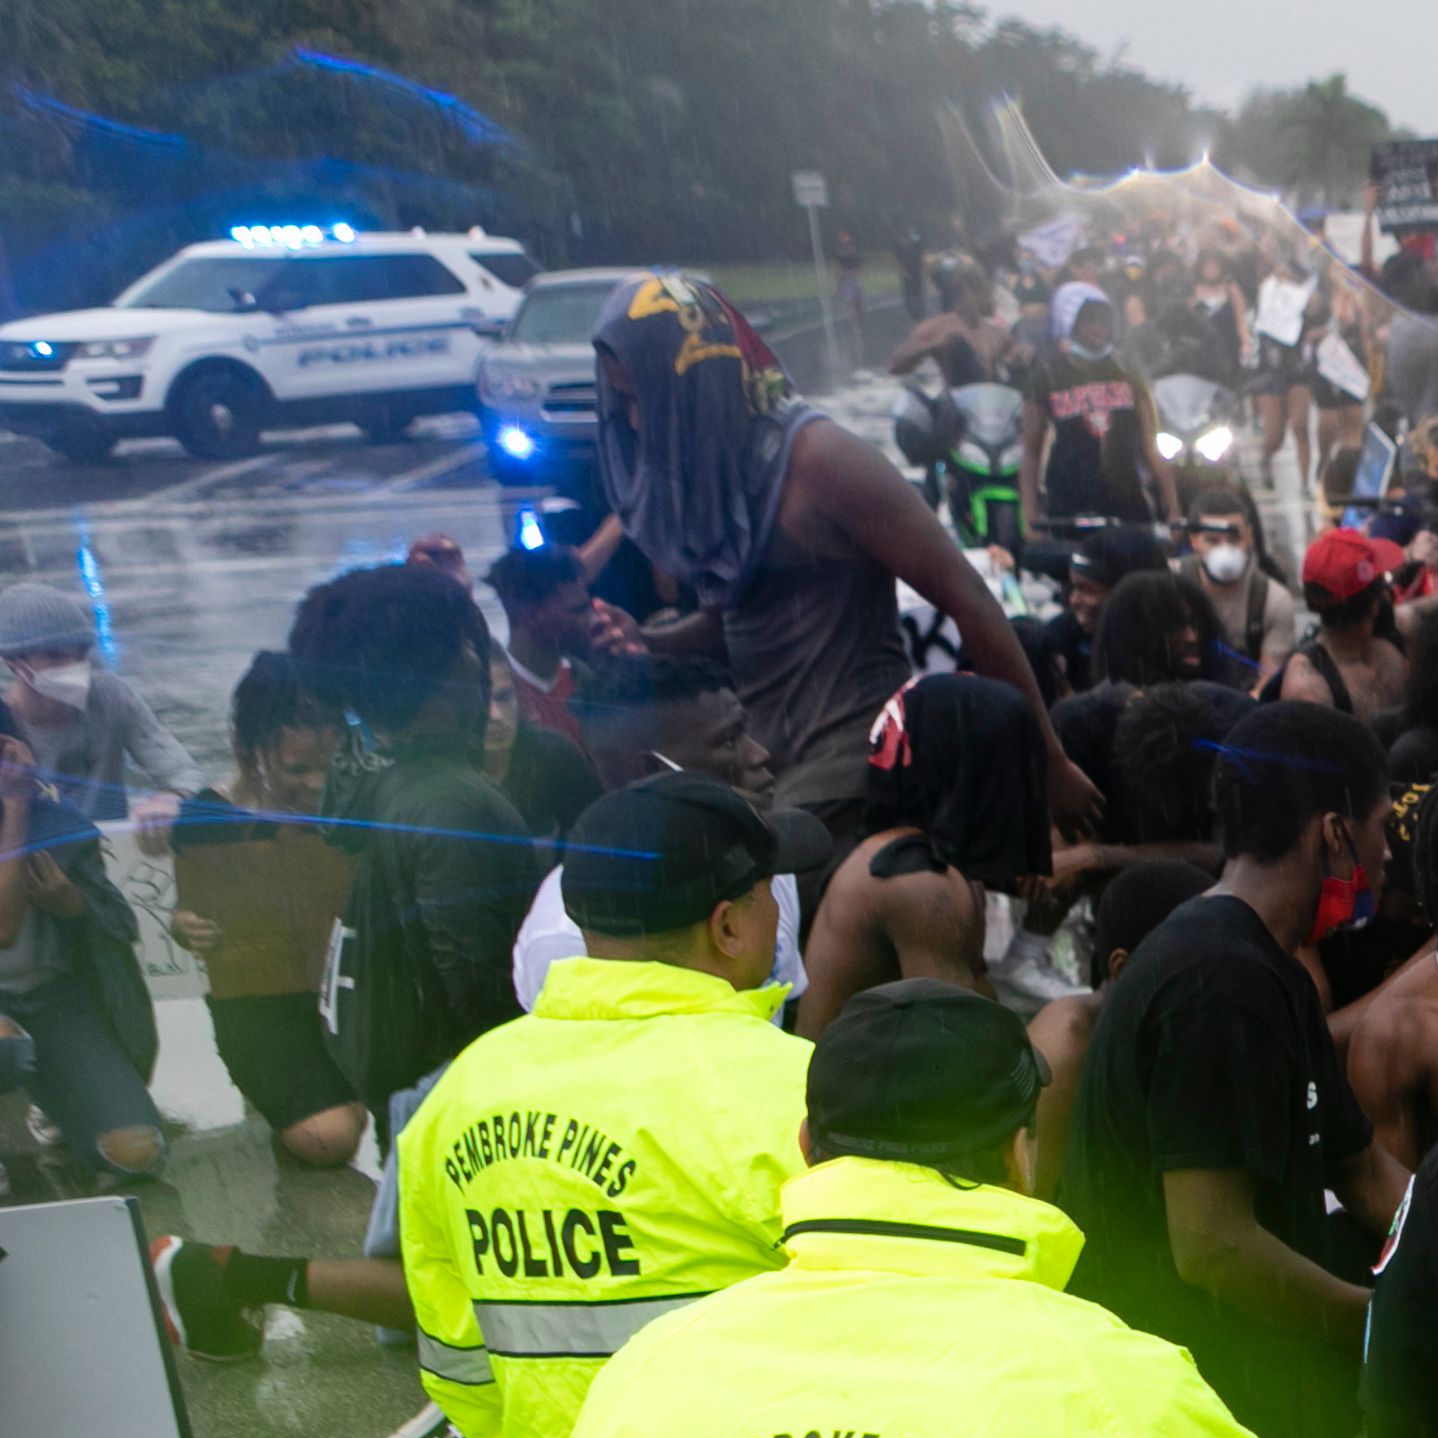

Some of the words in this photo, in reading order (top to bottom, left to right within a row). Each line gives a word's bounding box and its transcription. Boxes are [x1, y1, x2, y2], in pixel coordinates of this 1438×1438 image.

[445, 1111, 557, 1196] PEMBROKE
[557, 1118, 636, 1198] PINES
[465, 1208, 641, 1280] POLICE
